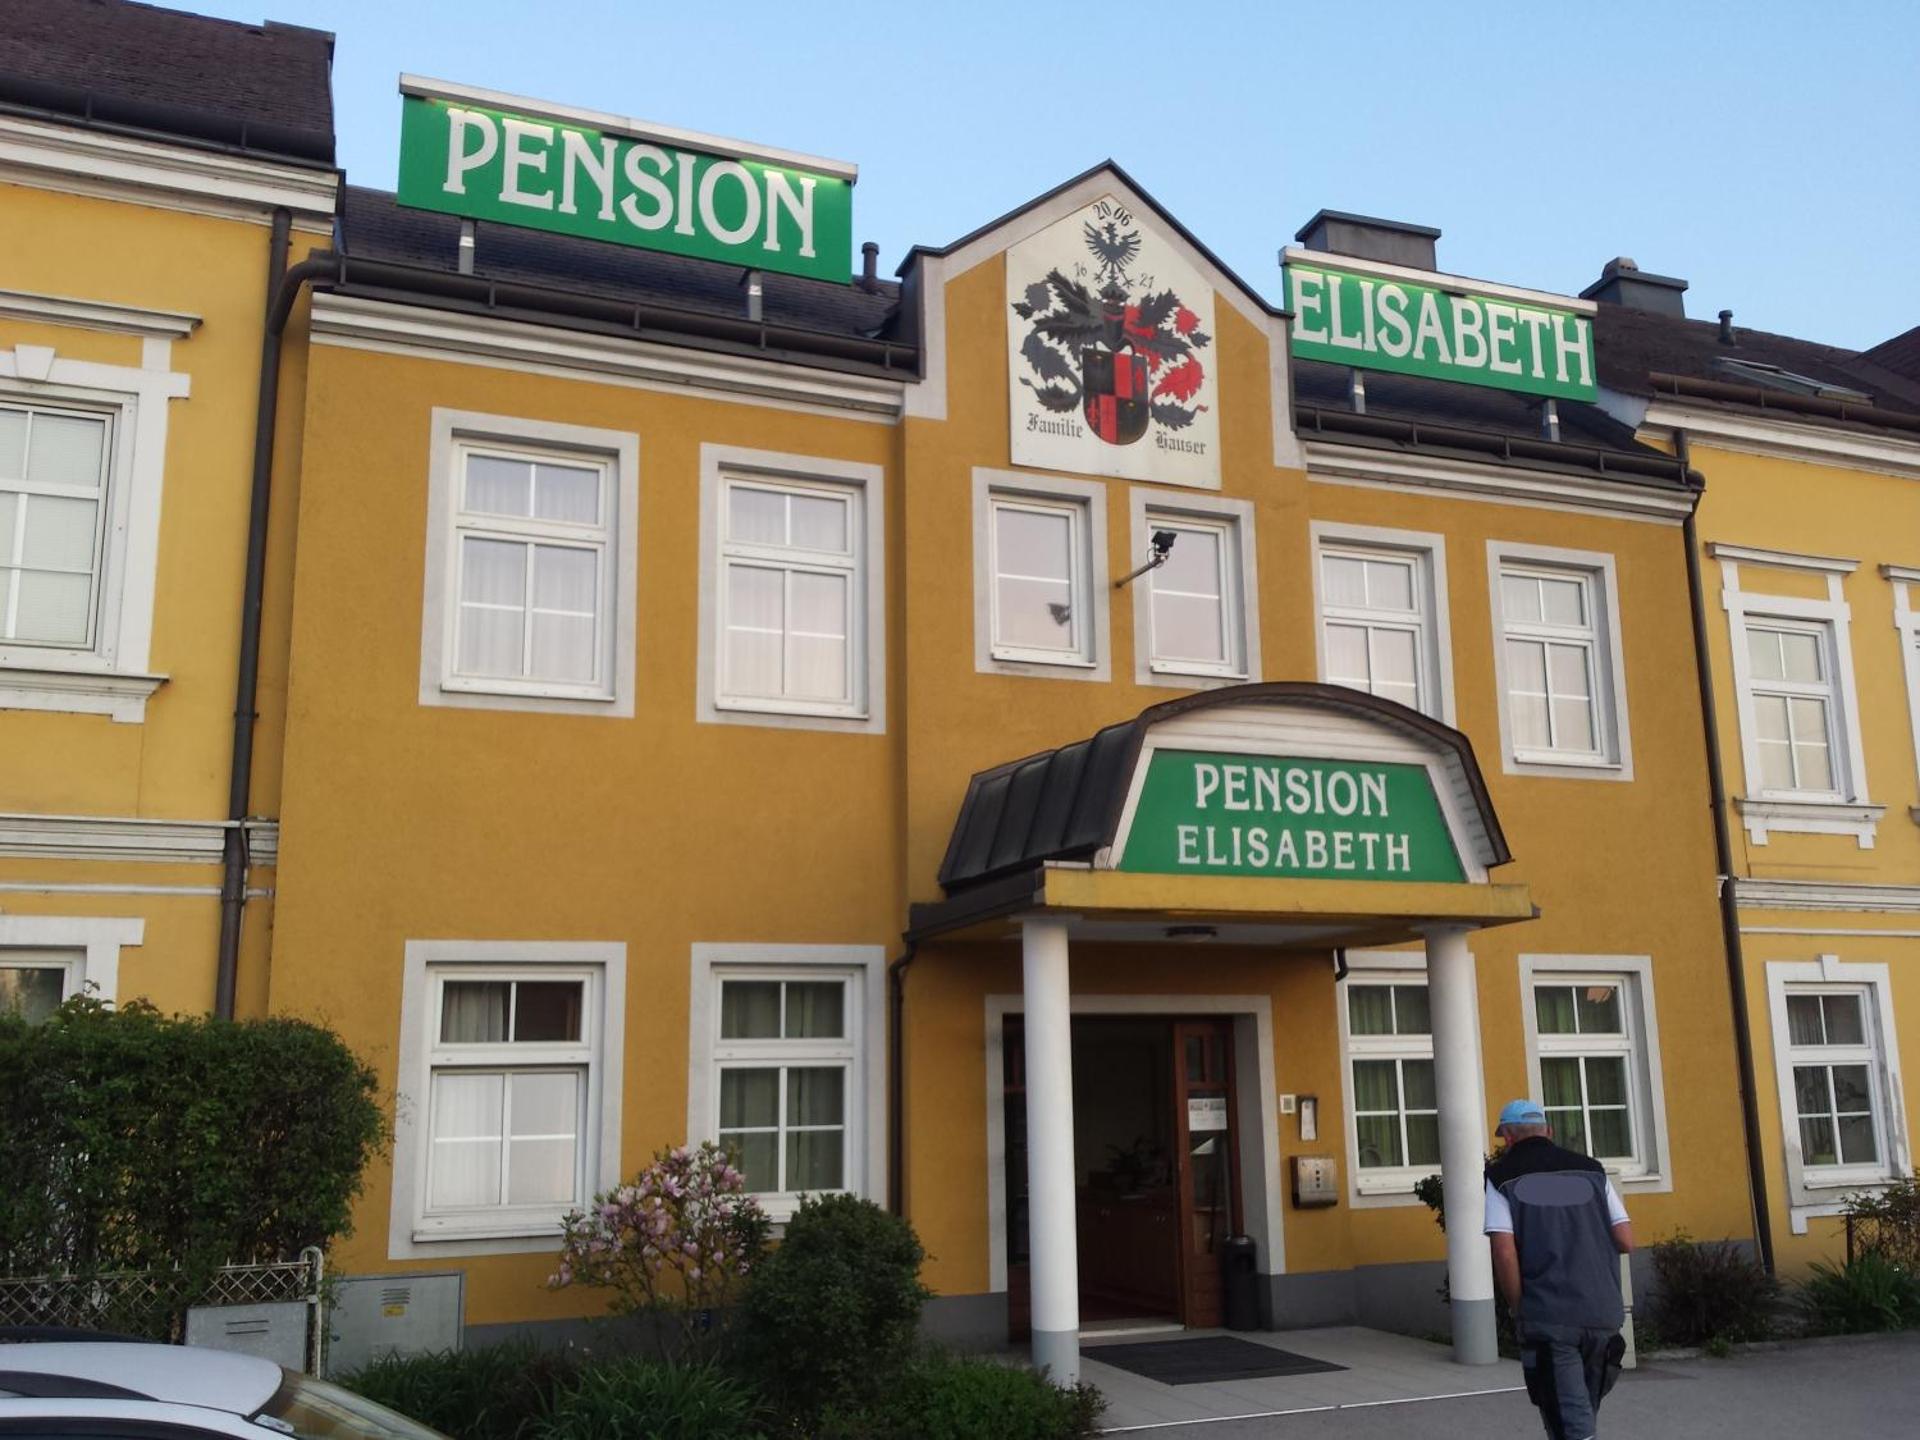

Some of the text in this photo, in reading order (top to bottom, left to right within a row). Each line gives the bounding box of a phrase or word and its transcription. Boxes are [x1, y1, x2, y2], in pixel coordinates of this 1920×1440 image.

[443, 107, 816, 258] PENSION
[1289, 268, 1593, 386] ELISABETH
[1026, 412, 1083, 438] Familie
[1193, 763, 1389, 817] PENSION
[1176, 824, 1411, 872] ELISABETH
